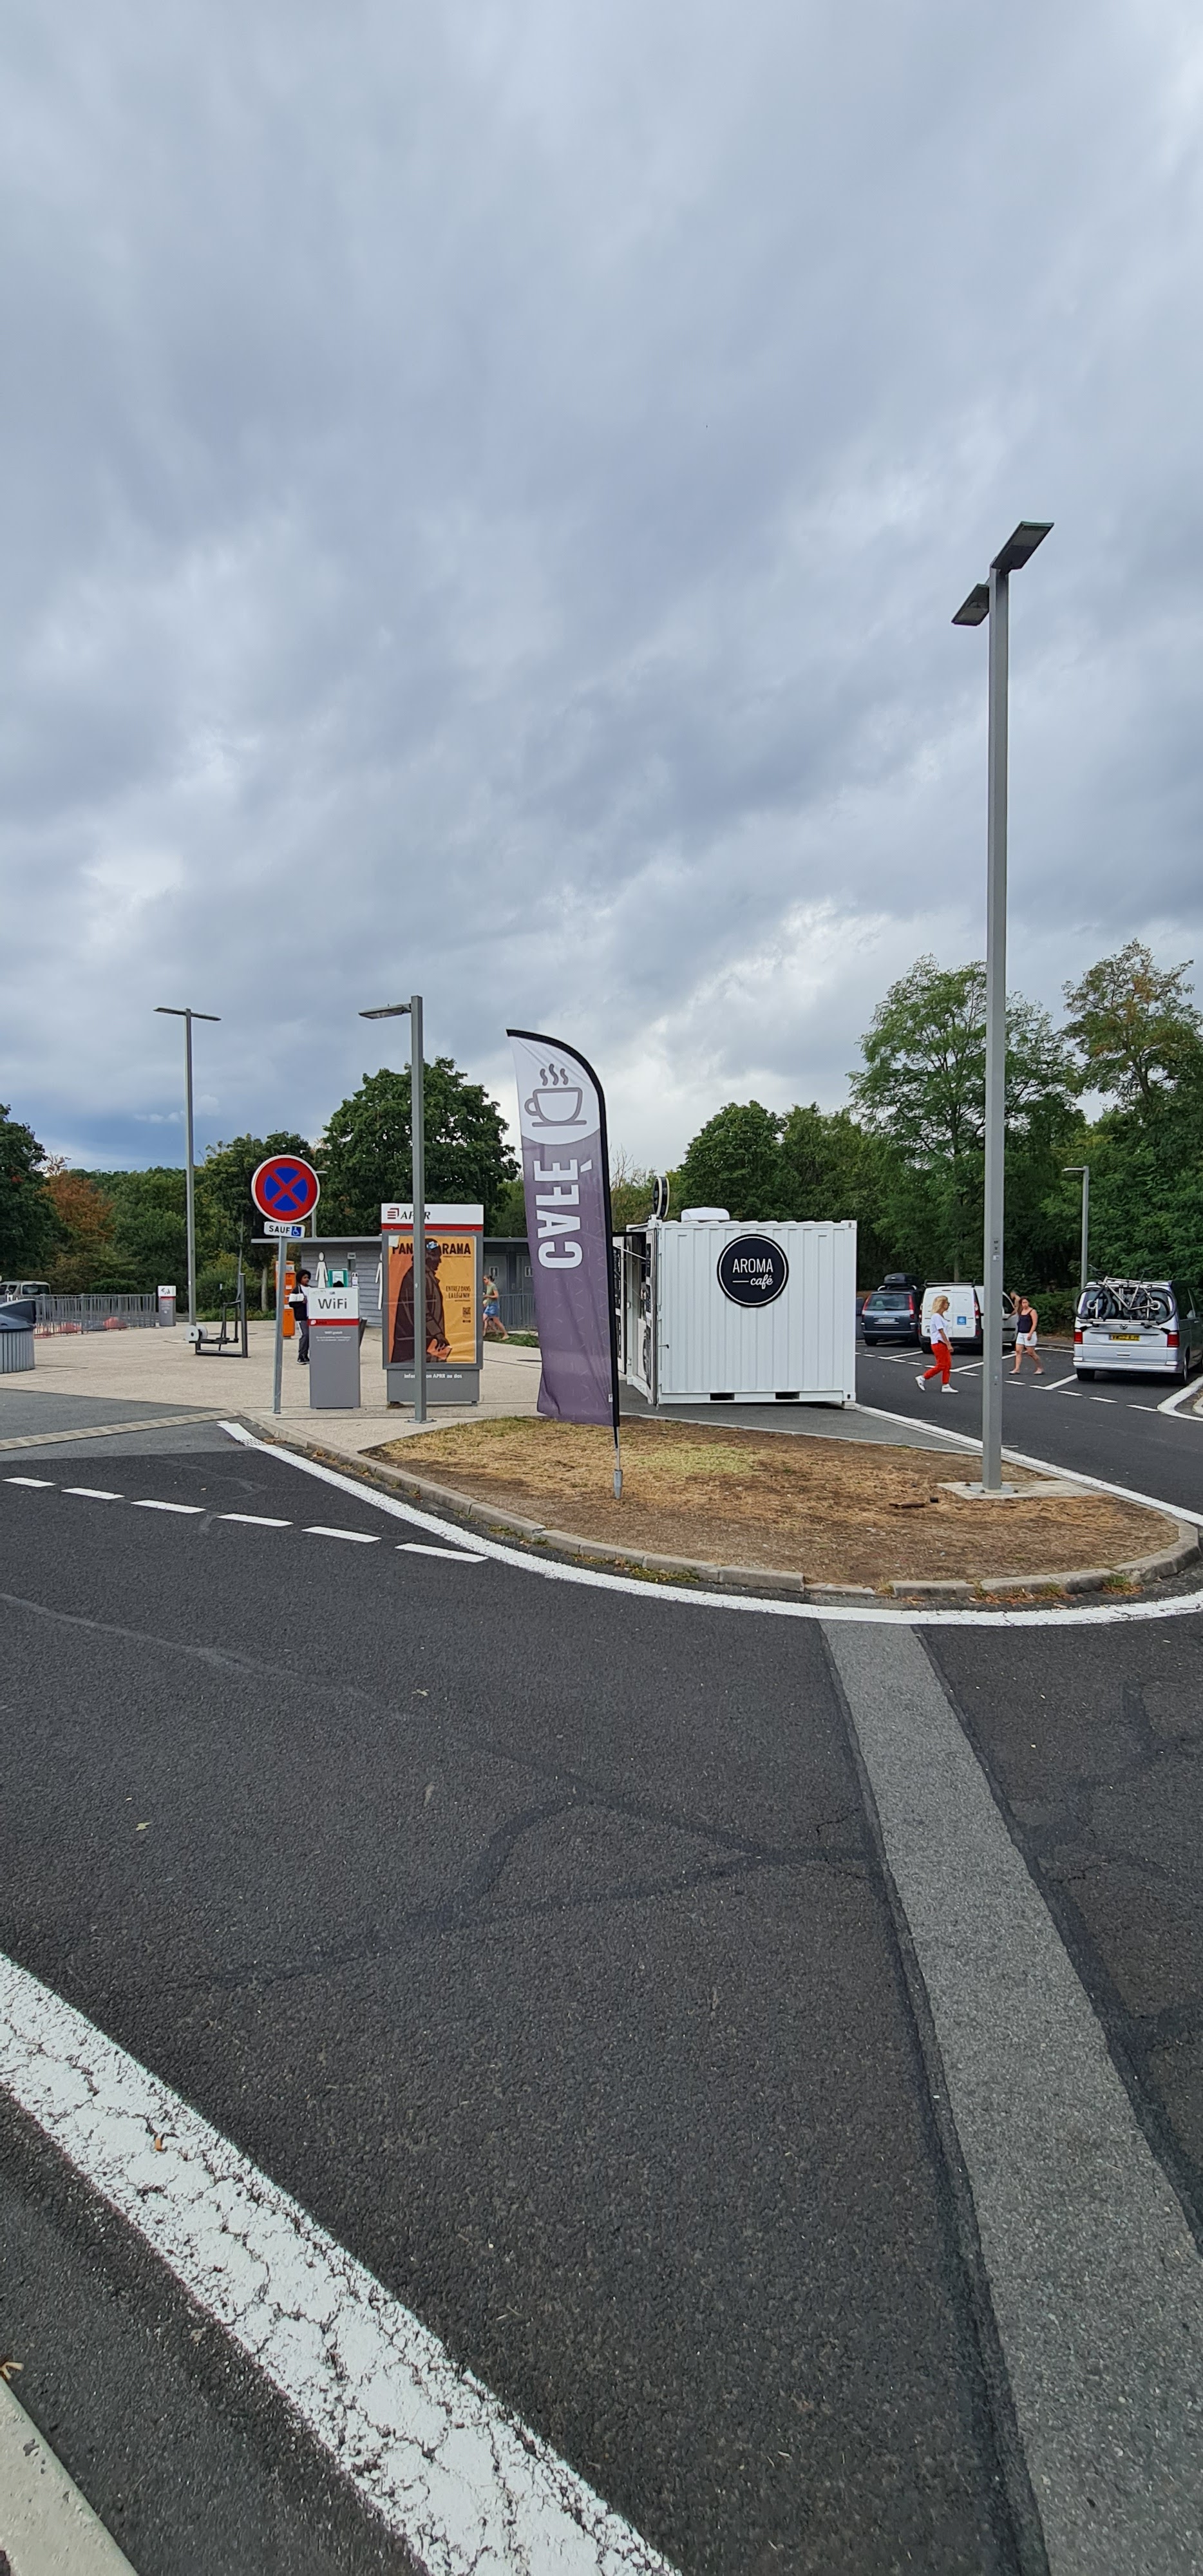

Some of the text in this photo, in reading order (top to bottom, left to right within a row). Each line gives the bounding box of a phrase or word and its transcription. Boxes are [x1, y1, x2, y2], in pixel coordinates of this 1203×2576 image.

[401, 1211, 431, 1220] APR
[269, 1226, 290, 1234] SAUF
[732, 1258, 773, 1273] AROMA
[750, 1274, 773, 1289] café
[318, 1298, 347, 1309] WiFi
